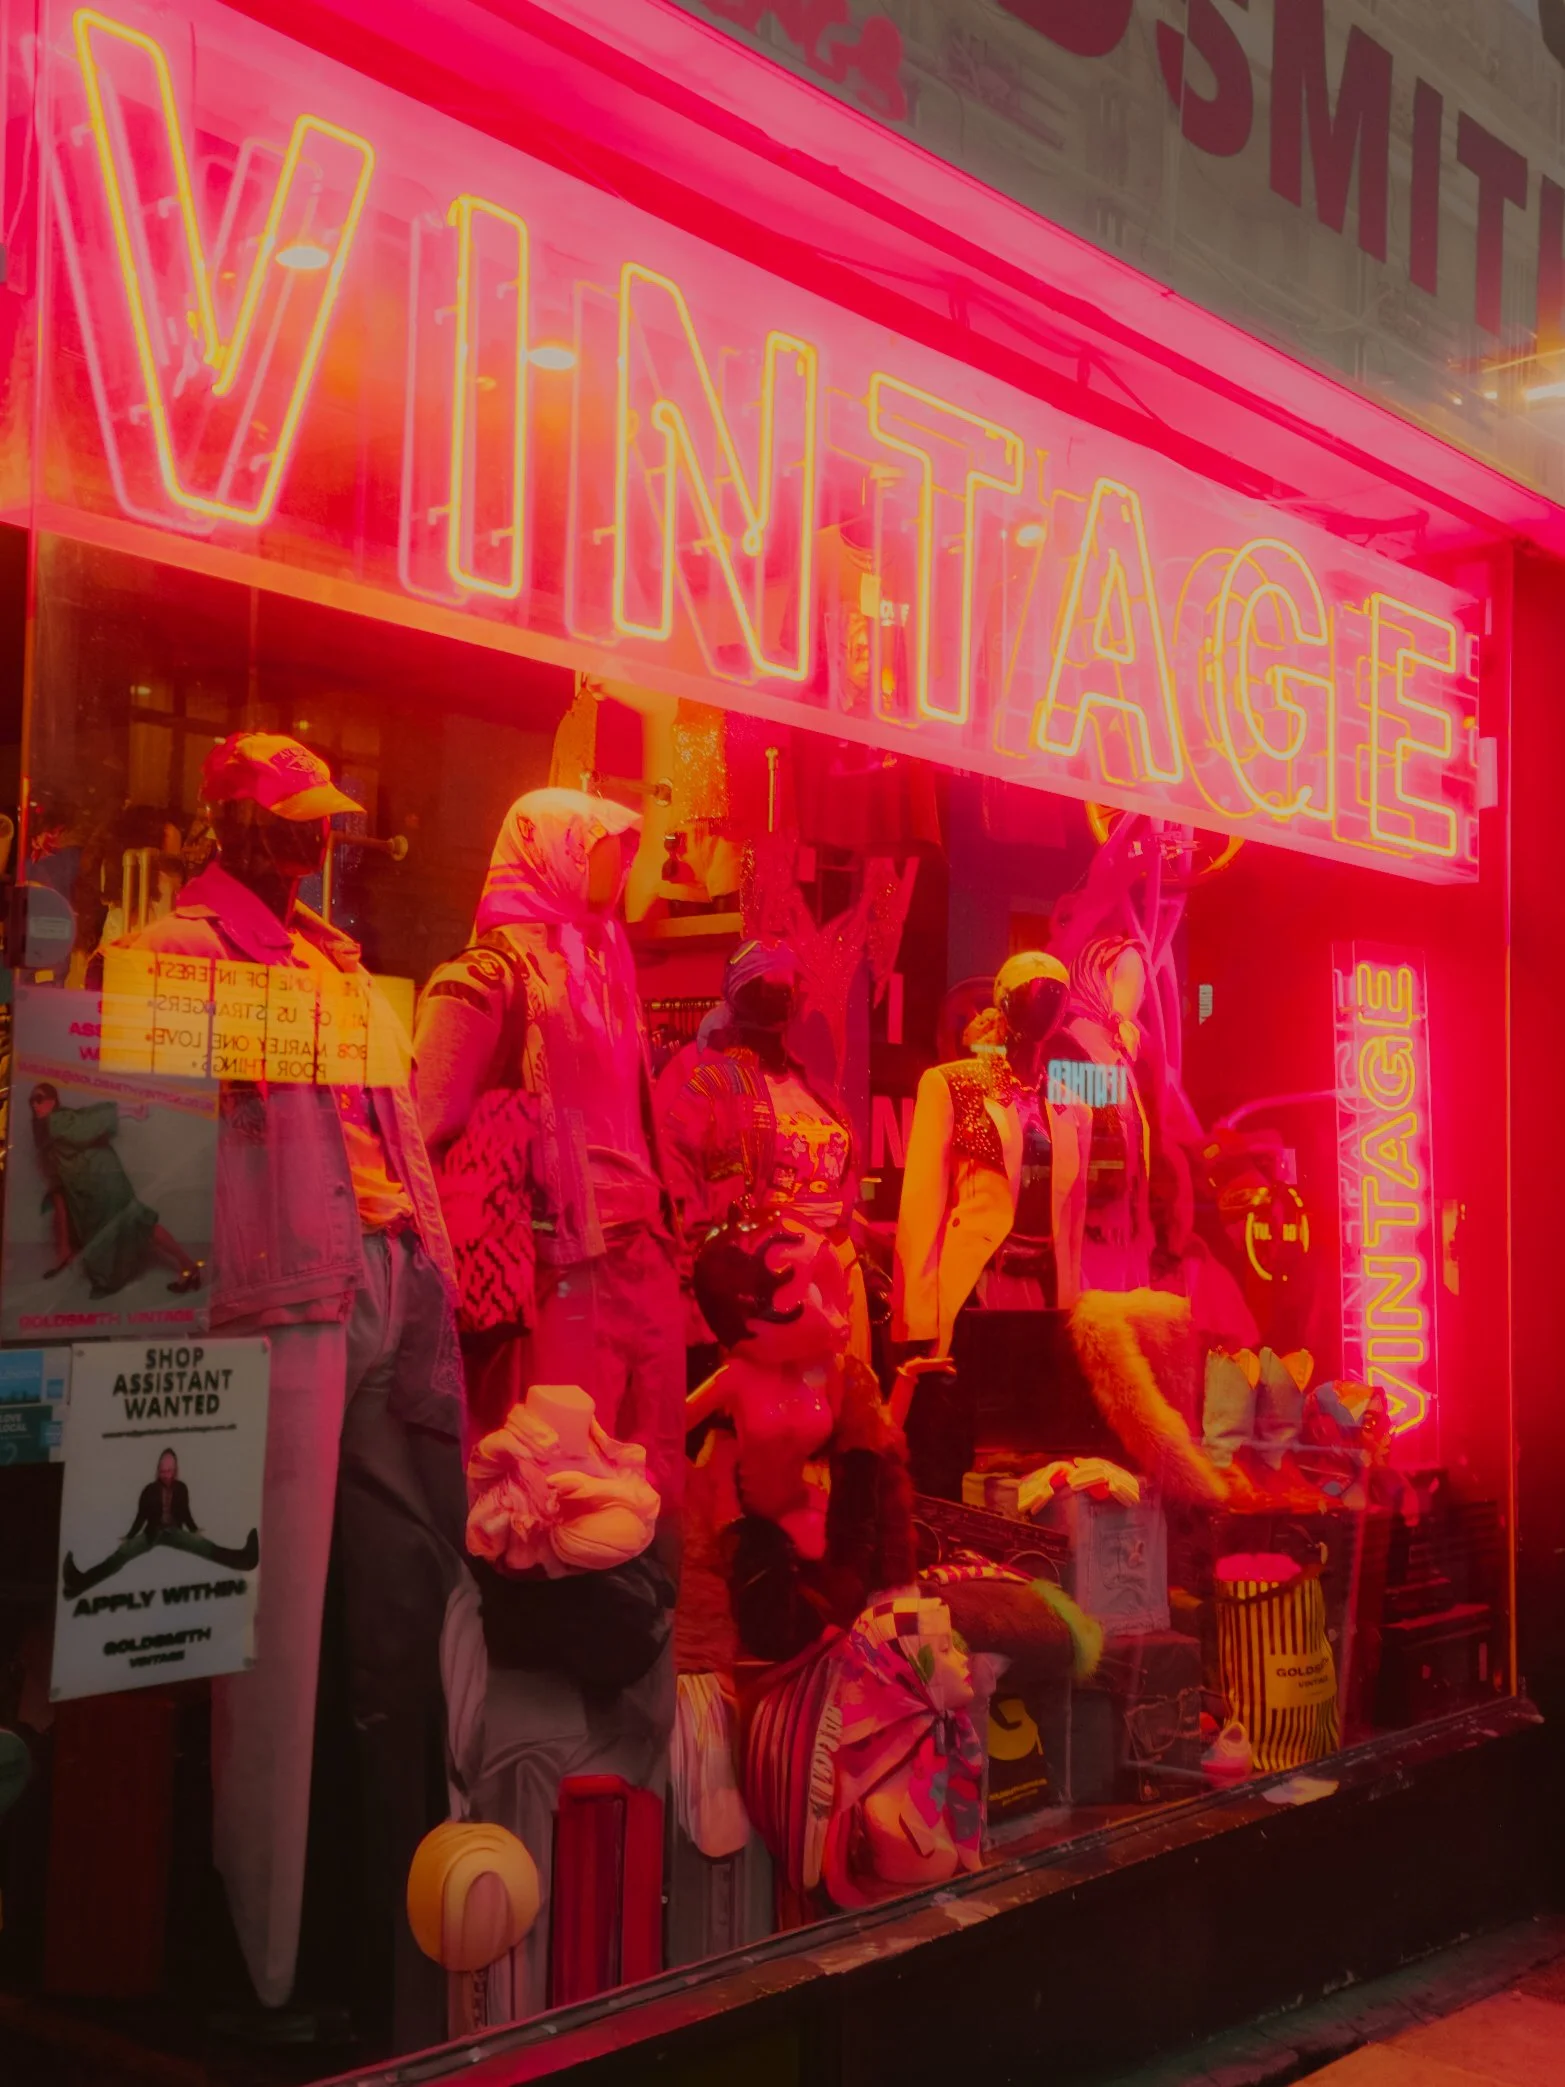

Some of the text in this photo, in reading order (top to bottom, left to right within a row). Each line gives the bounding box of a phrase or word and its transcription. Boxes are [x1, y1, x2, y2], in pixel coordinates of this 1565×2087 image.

[1012, 0, 1565, 350] SMIT
[73, 8, 1459, 858] VINTAGE
[1356, 962, 1426, 1435] VINTAGE
[145, 1347, 204, 1370] SHOP
[113, 1369, 233, 1397] ASSISTANT
[124, 1394, 220, 1421] WANTED
[73, 1579, 247, 1618] APPLY WITHIN
[104, 1627, 211, 1656] GOLDSMITH
